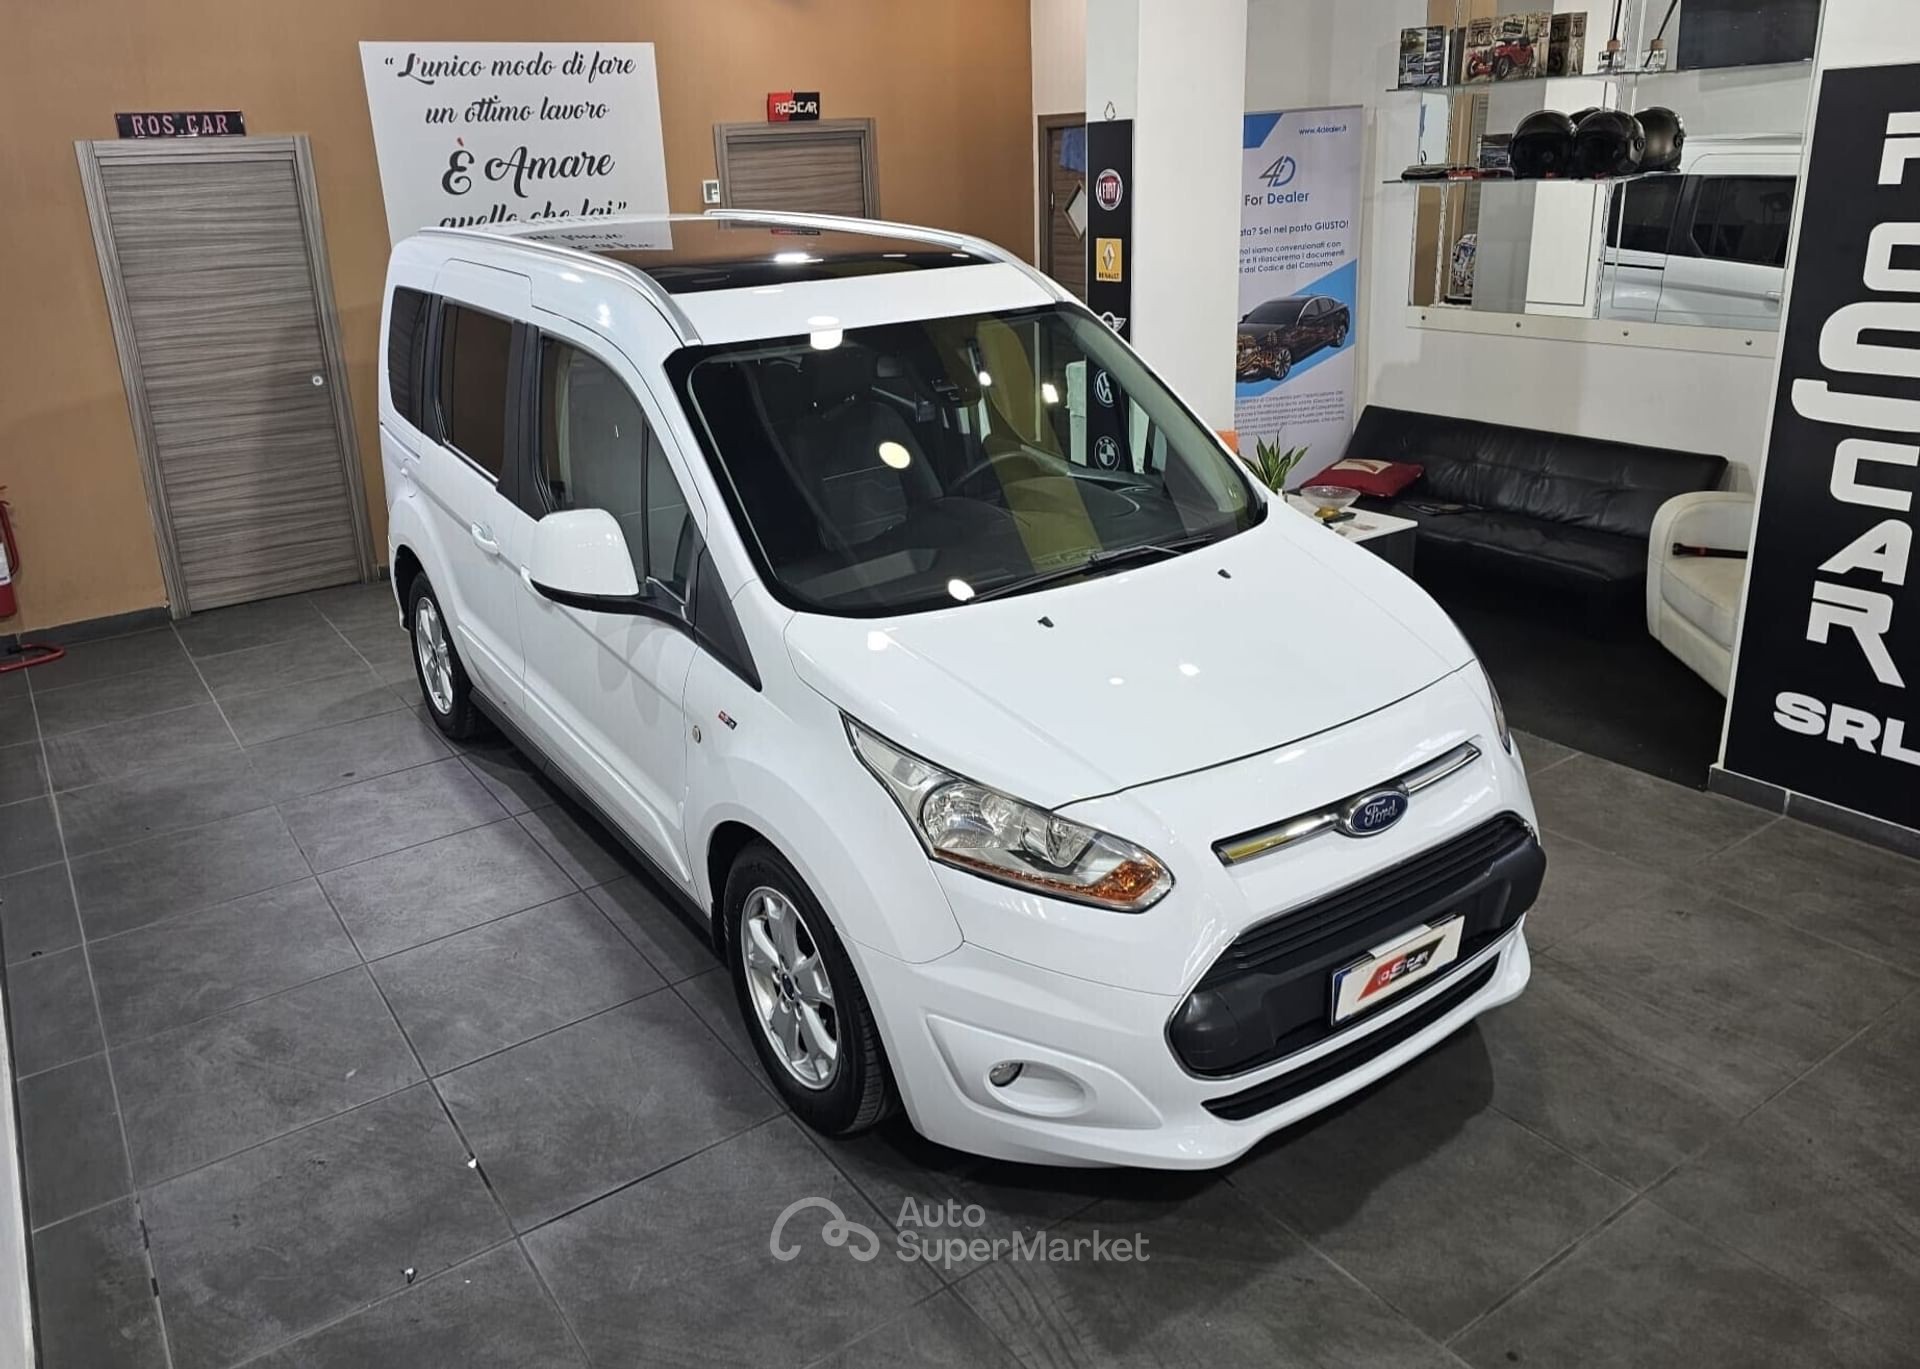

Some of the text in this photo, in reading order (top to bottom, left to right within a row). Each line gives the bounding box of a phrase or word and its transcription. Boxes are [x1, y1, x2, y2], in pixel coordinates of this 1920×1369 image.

[491, 51, 556, 76] modo
[562, 51, 585, 75] di
[588, 51, 636, 84] fare
[425, 95, 610, 124] un ottimo lavoro
[775, 101, 818, 115] ROSCAR
[441, 137, 616, 198] È Amare
[1245, 191, 1309, 206] For Dealer
[1289, 223, 1312, 234] posto
[1315, 219, 1349, 231] GIUSTO!
[1773, 691, 1920, 767] SRL
[1364, 799, 1398, 827] Ford
